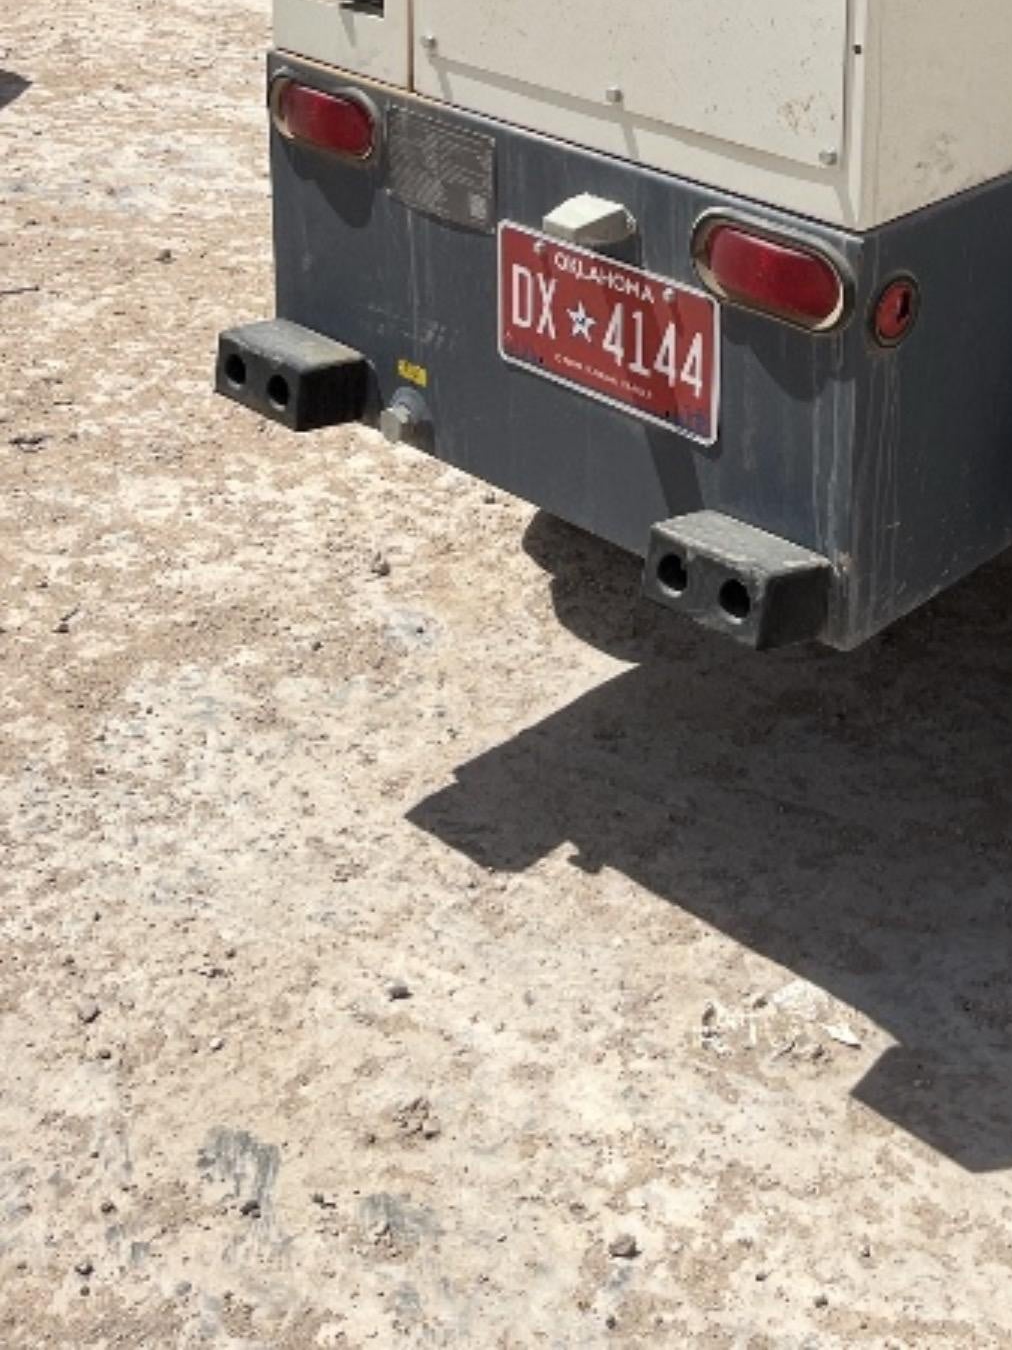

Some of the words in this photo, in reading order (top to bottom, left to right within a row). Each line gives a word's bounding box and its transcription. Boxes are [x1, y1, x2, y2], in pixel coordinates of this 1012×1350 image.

[554, 250, 655, 305] OKLAHOMA
[512, 262, 557, 341] DX
[602, 302, 704, 399] 4144
